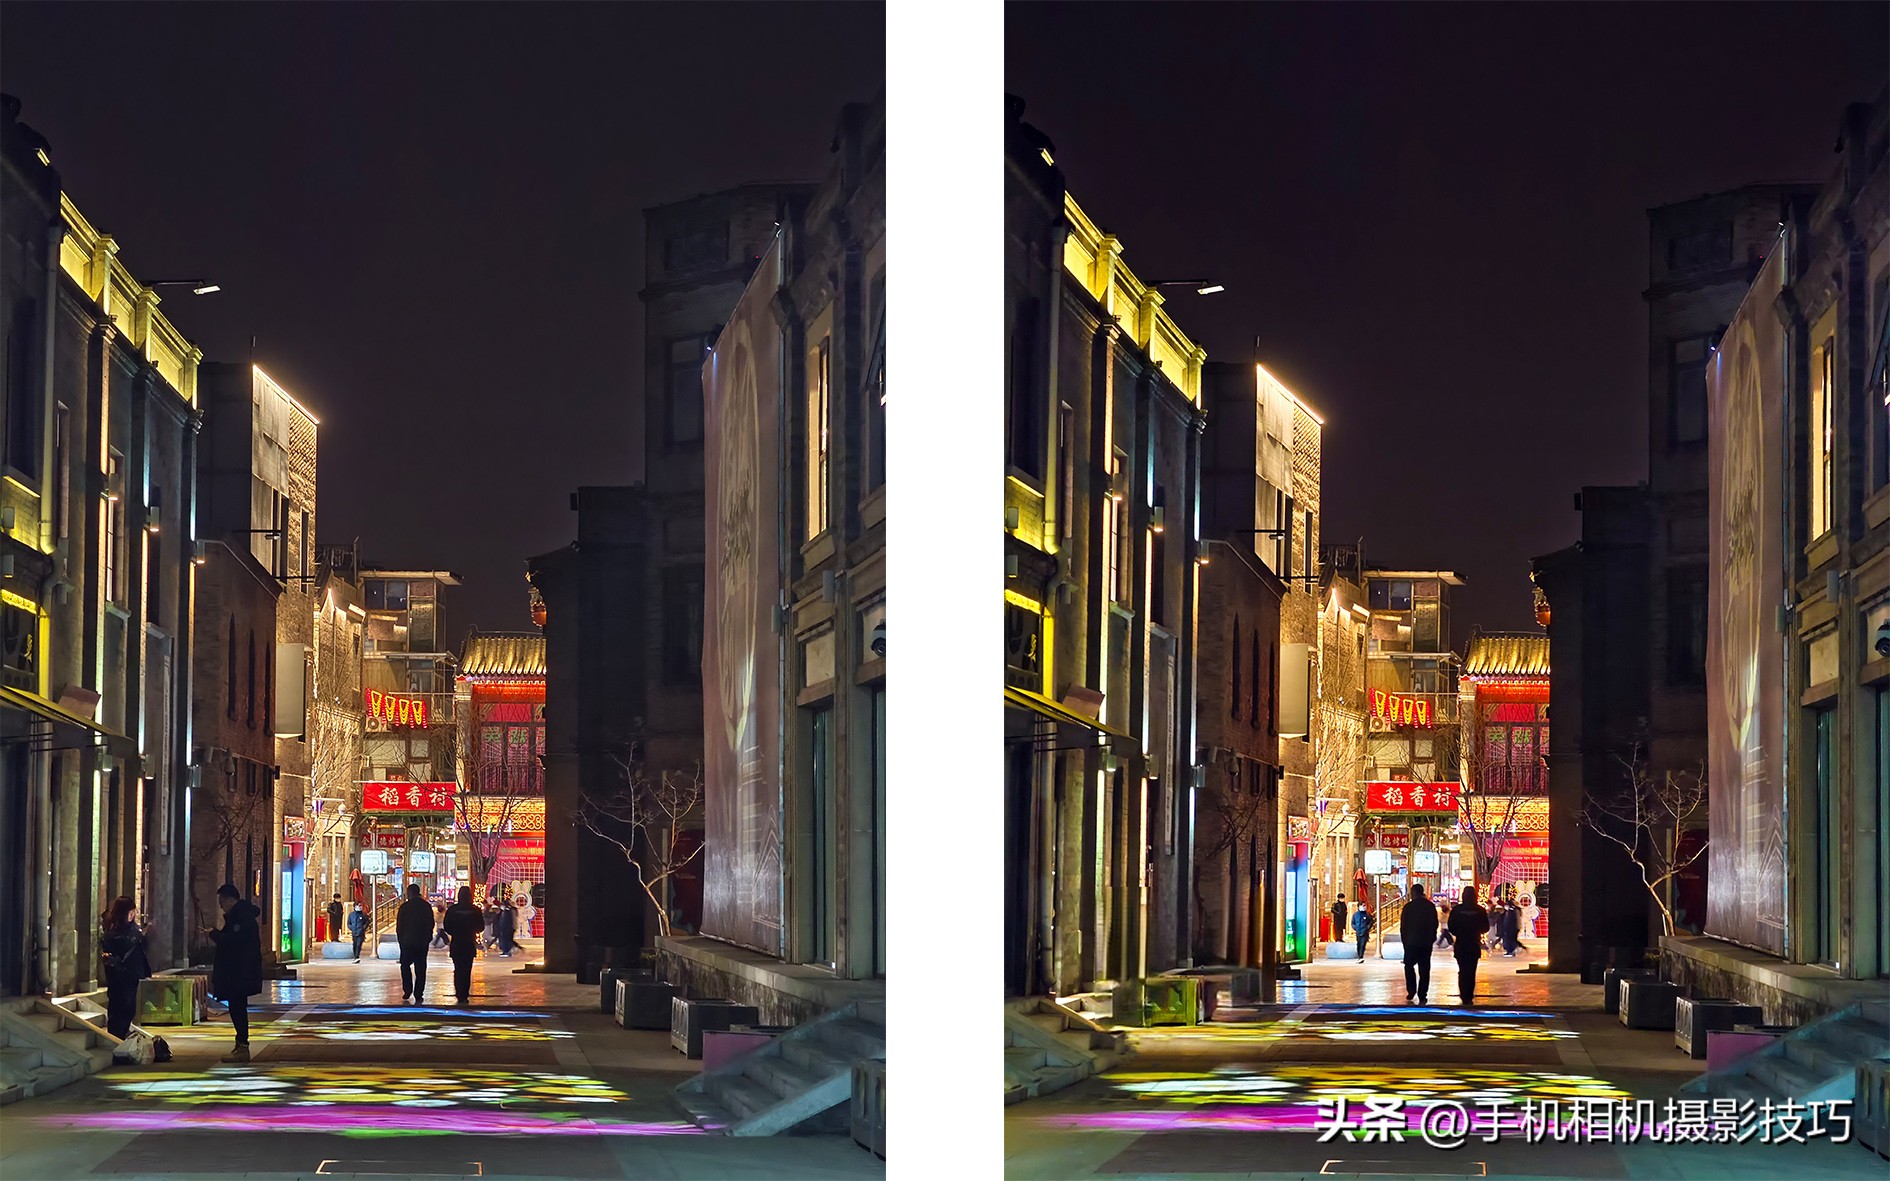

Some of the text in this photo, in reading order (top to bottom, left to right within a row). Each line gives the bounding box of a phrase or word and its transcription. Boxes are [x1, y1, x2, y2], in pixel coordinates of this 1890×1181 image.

[378, 785, 447, 807] 稻香村
[1382, 785, 1452, 807] 稻香村
